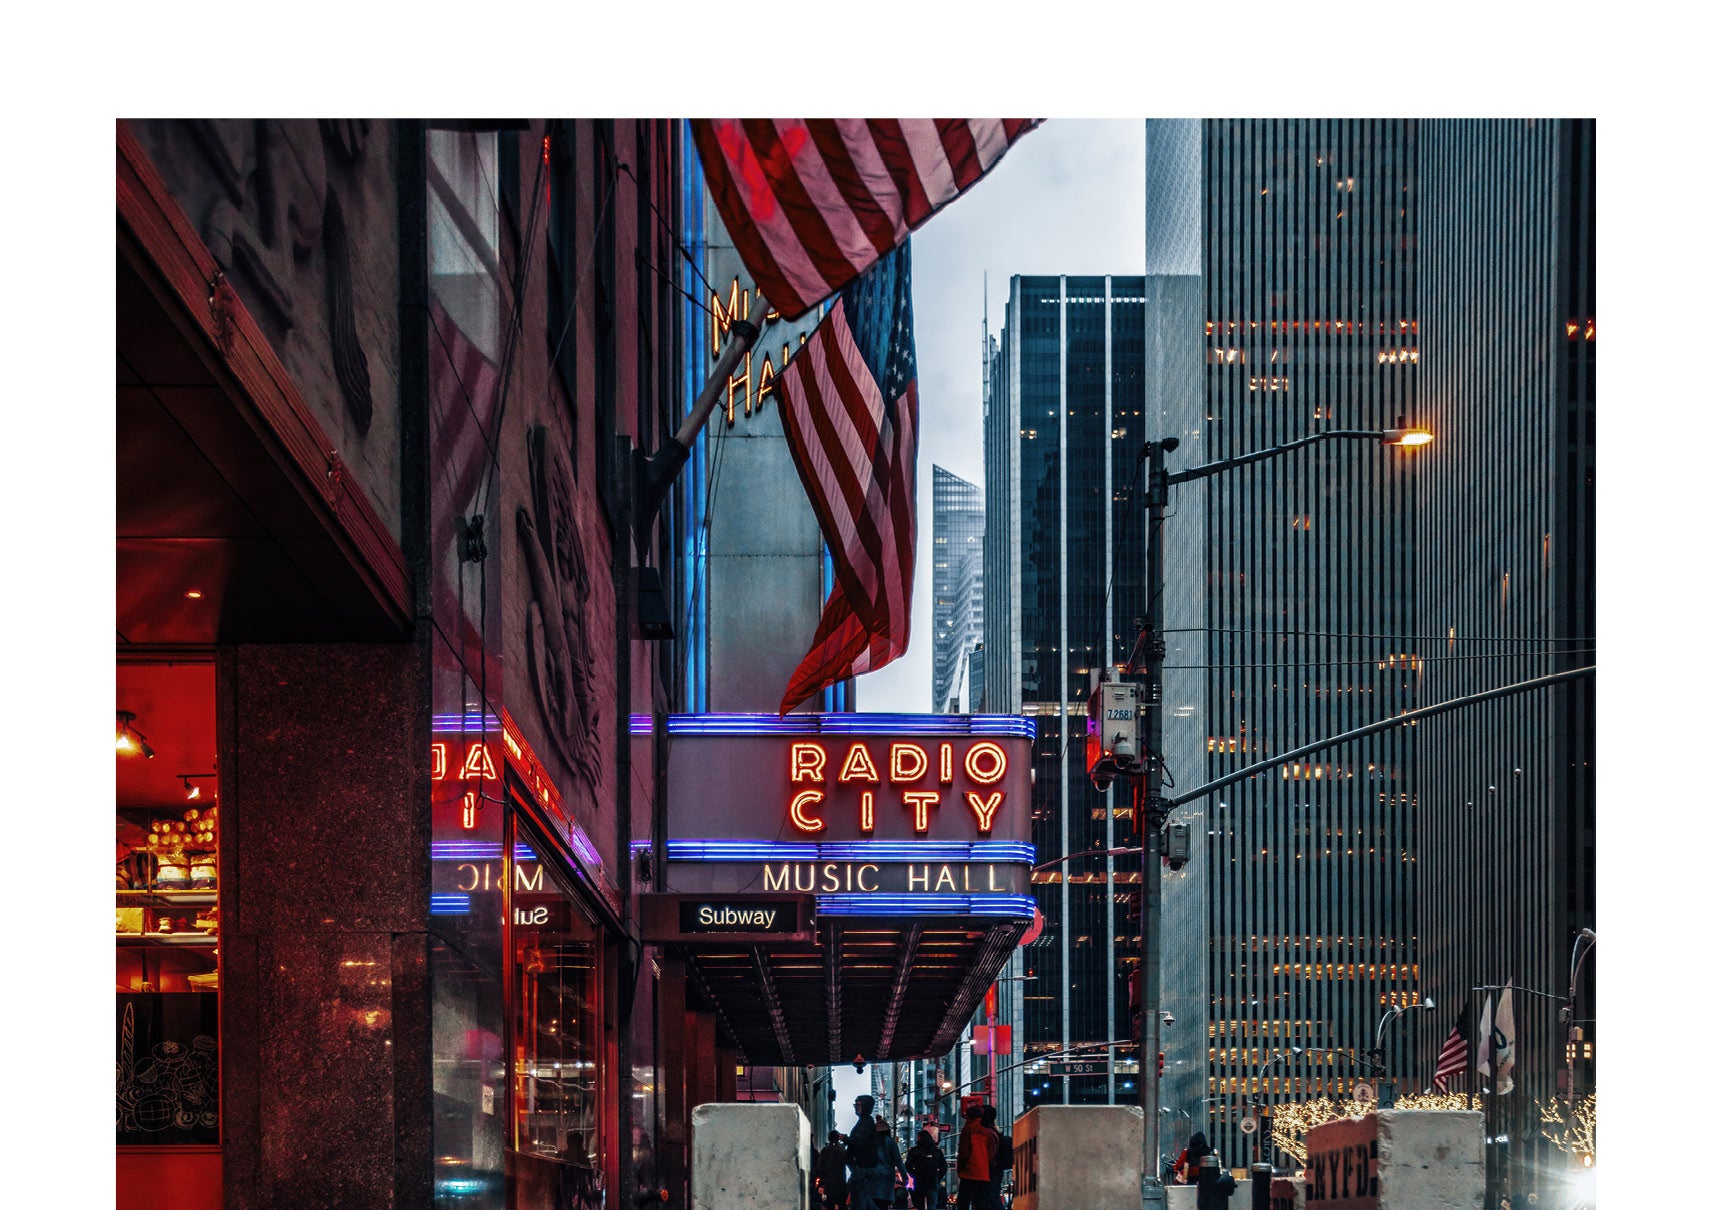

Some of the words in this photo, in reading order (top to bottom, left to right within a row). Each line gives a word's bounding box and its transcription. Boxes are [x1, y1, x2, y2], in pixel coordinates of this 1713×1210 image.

[790, 742, 1008, 784] RADIO
[789, 790, 1006, 832] CITY
[763, 864, 880, 892] MUSIC
[908, 864, 1006, 892] HALL
[699, 907, 776, 929] Subway
[1065, 1065, 1071, 1073] W
[1073, 1064, 1083, 1073] 50
